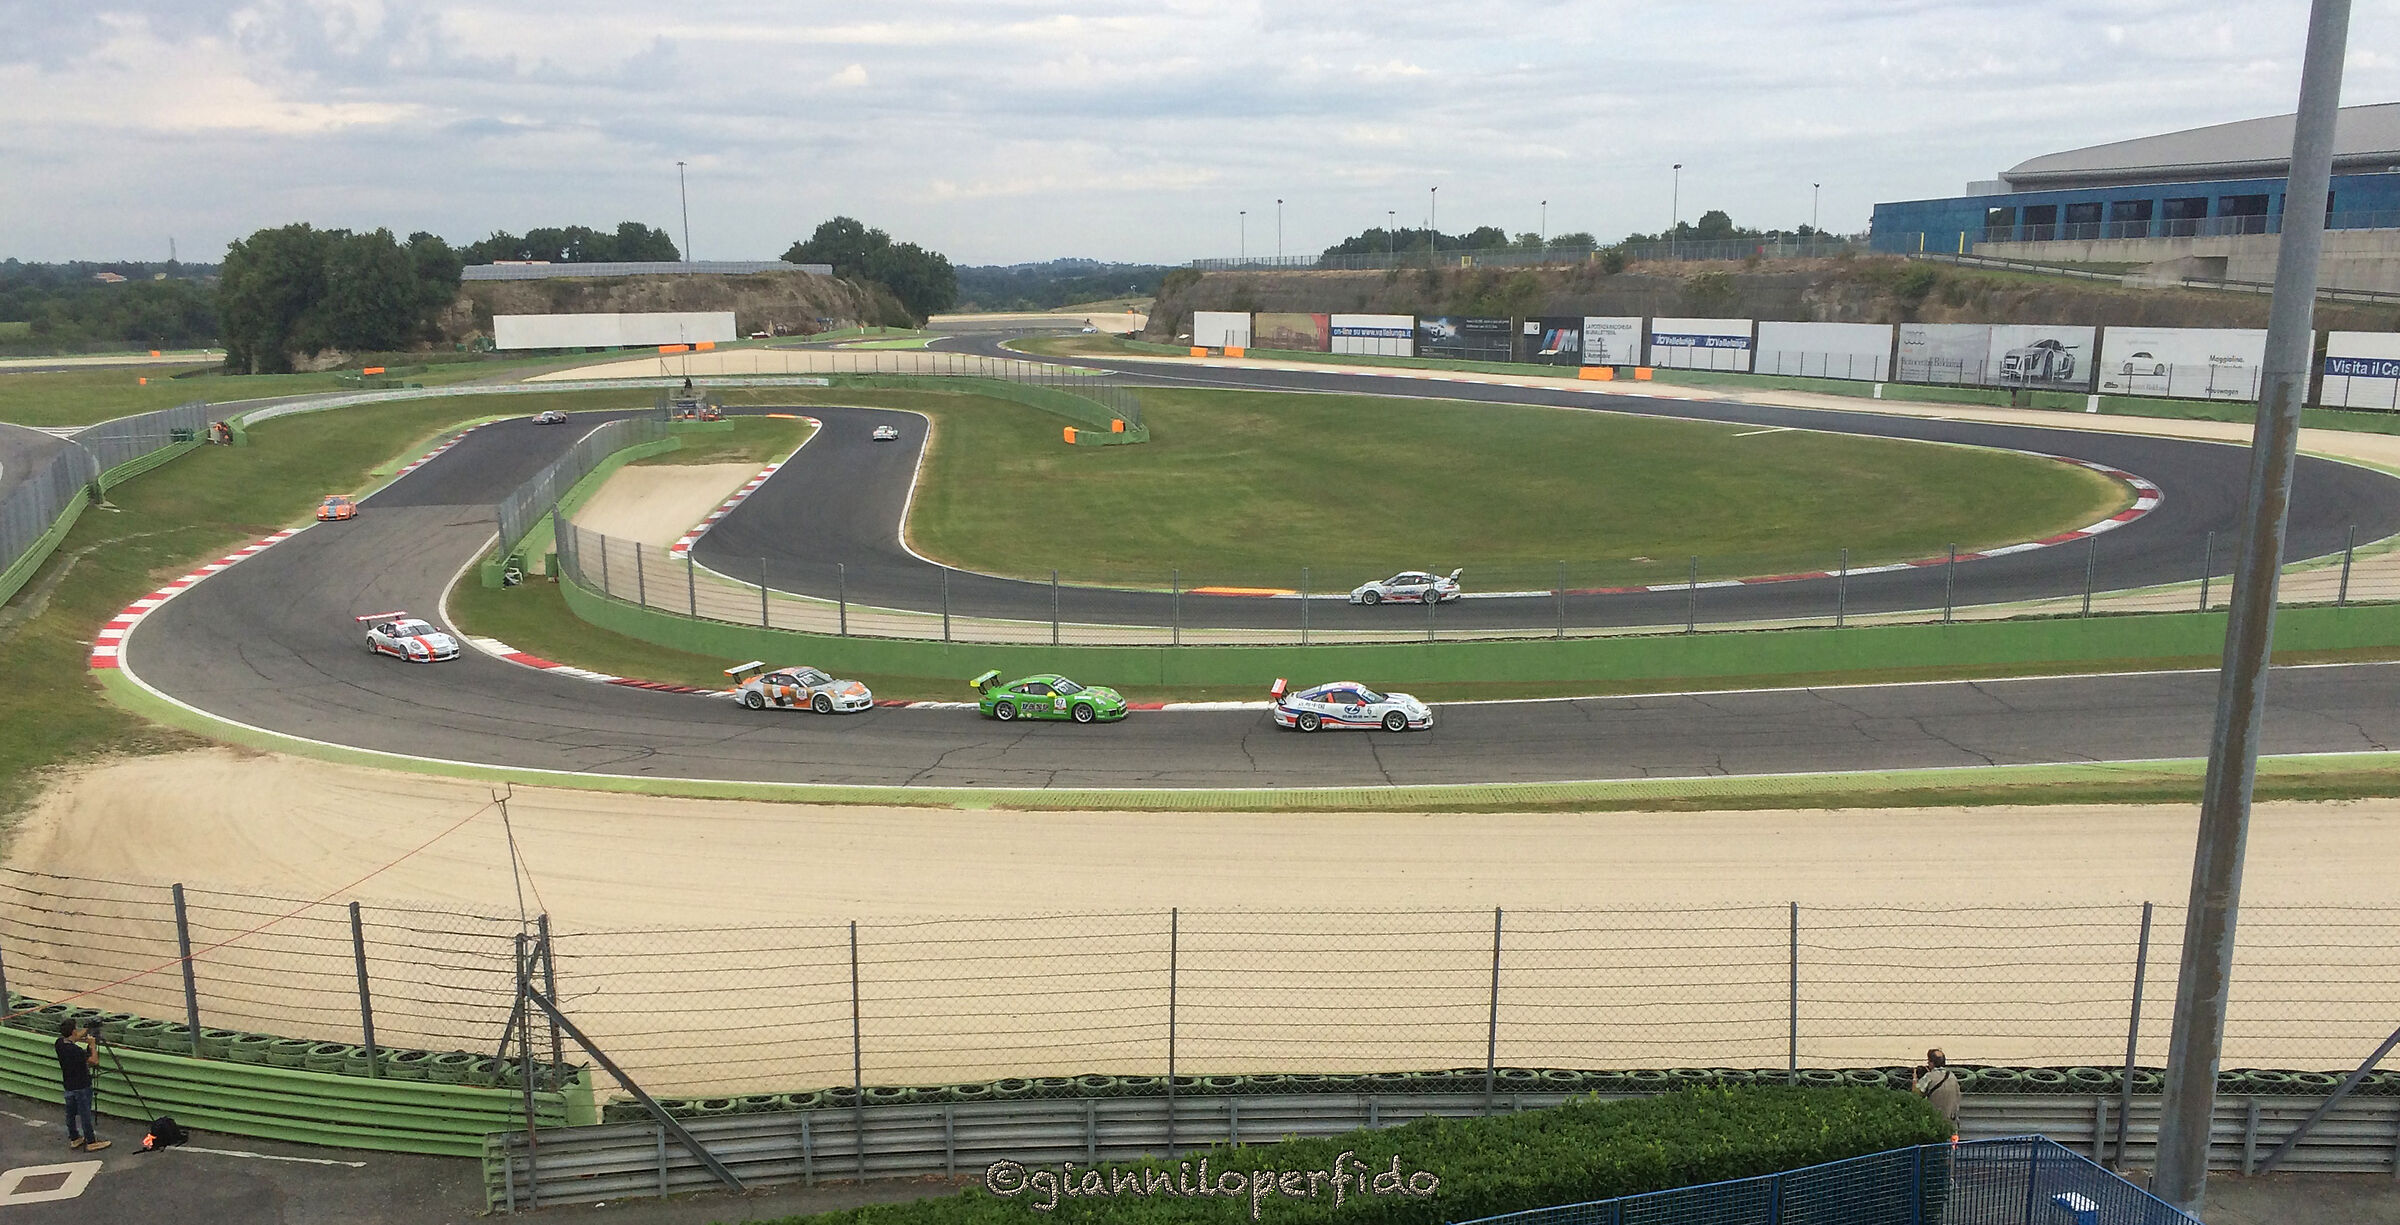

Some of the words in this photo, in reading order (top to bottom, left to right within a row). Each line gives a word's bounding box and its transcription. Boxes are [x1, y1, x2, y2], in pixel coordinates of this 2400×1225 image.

[2333, 360, 2368, 375] Visita
[2371, 361, 2380, 375] il
[2381, 362, 2400, 376] Ce
